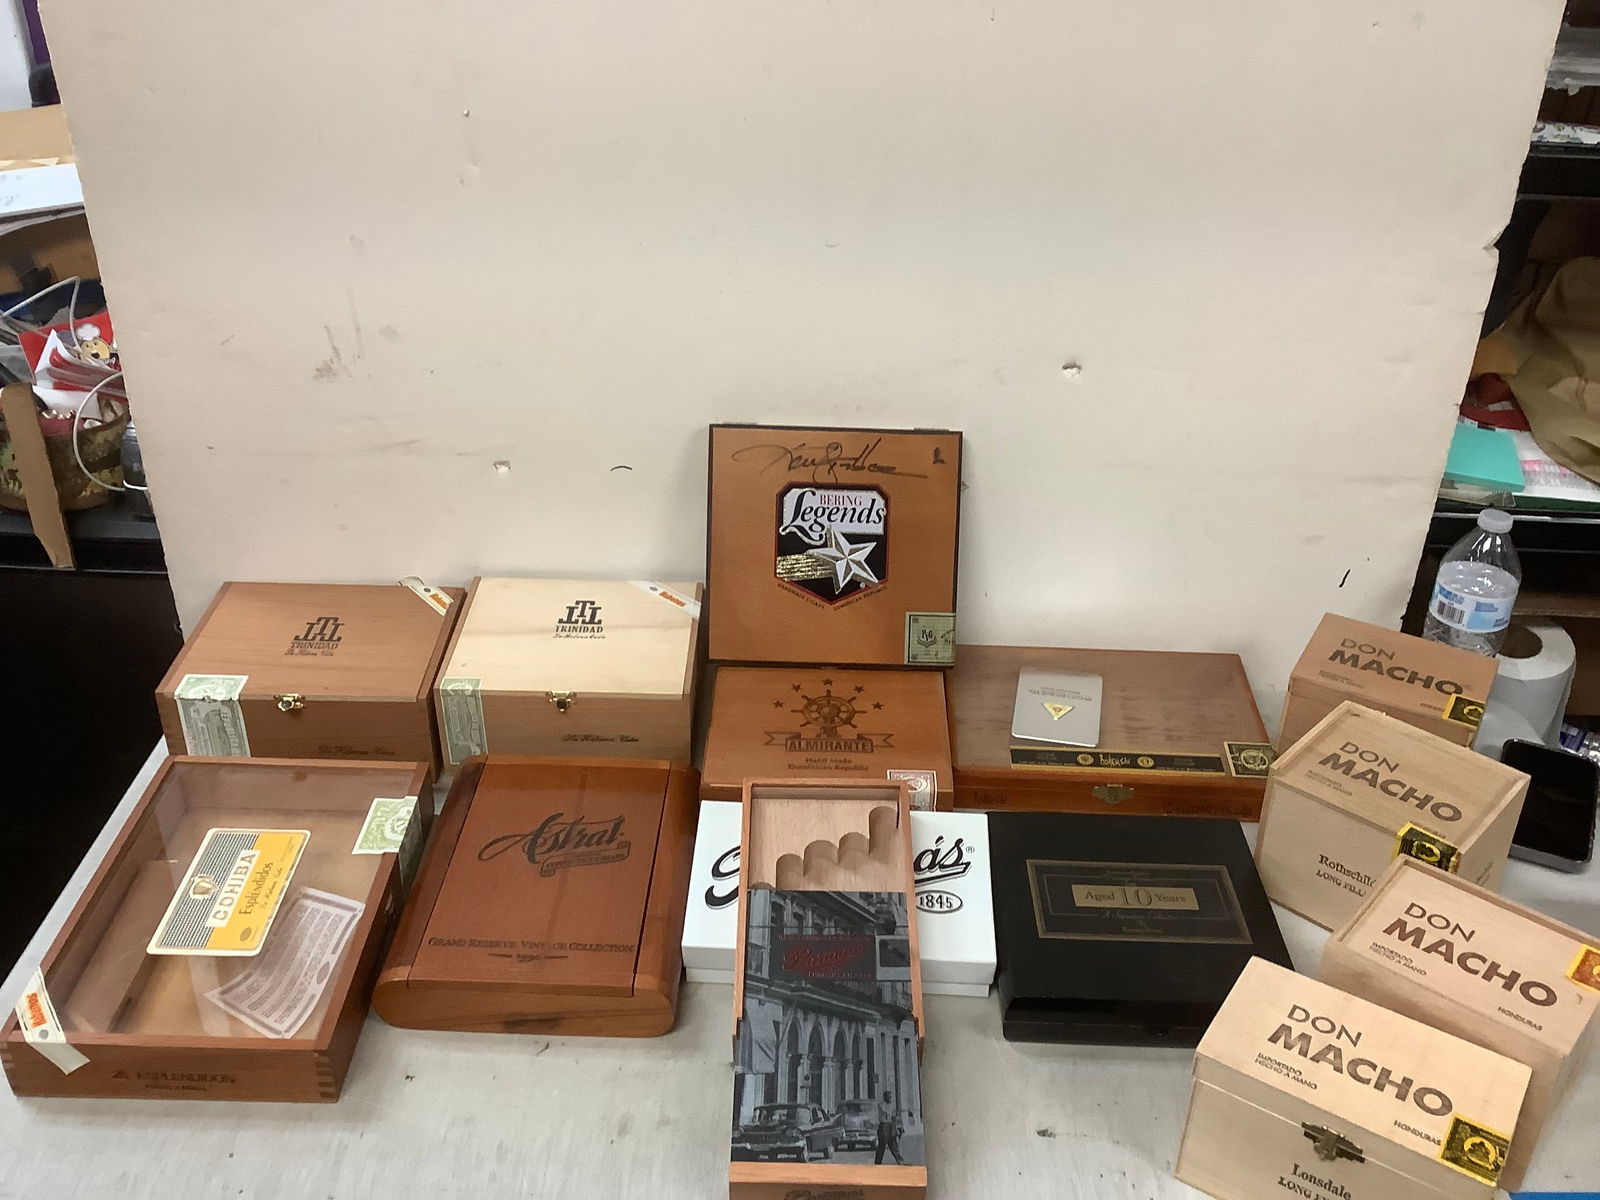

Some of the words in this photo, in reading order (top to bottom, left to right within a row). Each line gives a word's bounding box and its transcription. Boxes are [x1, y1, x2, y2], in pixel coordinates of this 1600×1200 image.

[820, 494, 862, 506] BERING
[781, 489, 885, 542] Legends
[555, 625, 604, 633] TRINIDAD
[290, 641, 339, 650] TRINIDAD
[1340, 638, 1396, 661] DON
[1328, 649, 1464, 696] MACHO
[788, 739, 872, 752] ALMIRANTE
[1339, 741, 1400, 773] DON
[1318, 752, 1463, 822] MACHO
[478, 812, 626, 864] Astral
[212, 853, 256, 921] COHIBA
[1315, 869, 1342, 887] LONG
[918, 893, 954, 909] 1845
[1084, 891, 1115, 902] Aged
[1119, 887, 1153, 907] 10
[1155, 893, 1187, 902] Years
[1404, 902, 1476, 943] DON
[428, 937, 467, 948] GRAND
[468, 938, 517, 949] RESERVE
[568, 942, 634, 953] COLLECTION
[1371, 942, 1414, 965] IMPORTADO
[1369, 945, 1395, 961] HECHO
[1402, 961, 1427, 976] MANO
[1382, 917, 1558, 1007] MACHO
[1287, 1004, 1363, 1048] DON
[1497, 1006, 1543, 1031] HONDURAS
[1254, 1057, 1283, 1075] HECHO
[1291, 1076, 1318, 1090] MANO
[1257, 1052, 1303, 1077] IMPORTADO
[1267, 1023, 1453, 1117] MACHO
[1393, 1119, 1442, 1147] HONDURAS
[1277, 1175, 1313, 1199] LONG
[1290, 1162, 1352, 1200] Lonsdale
